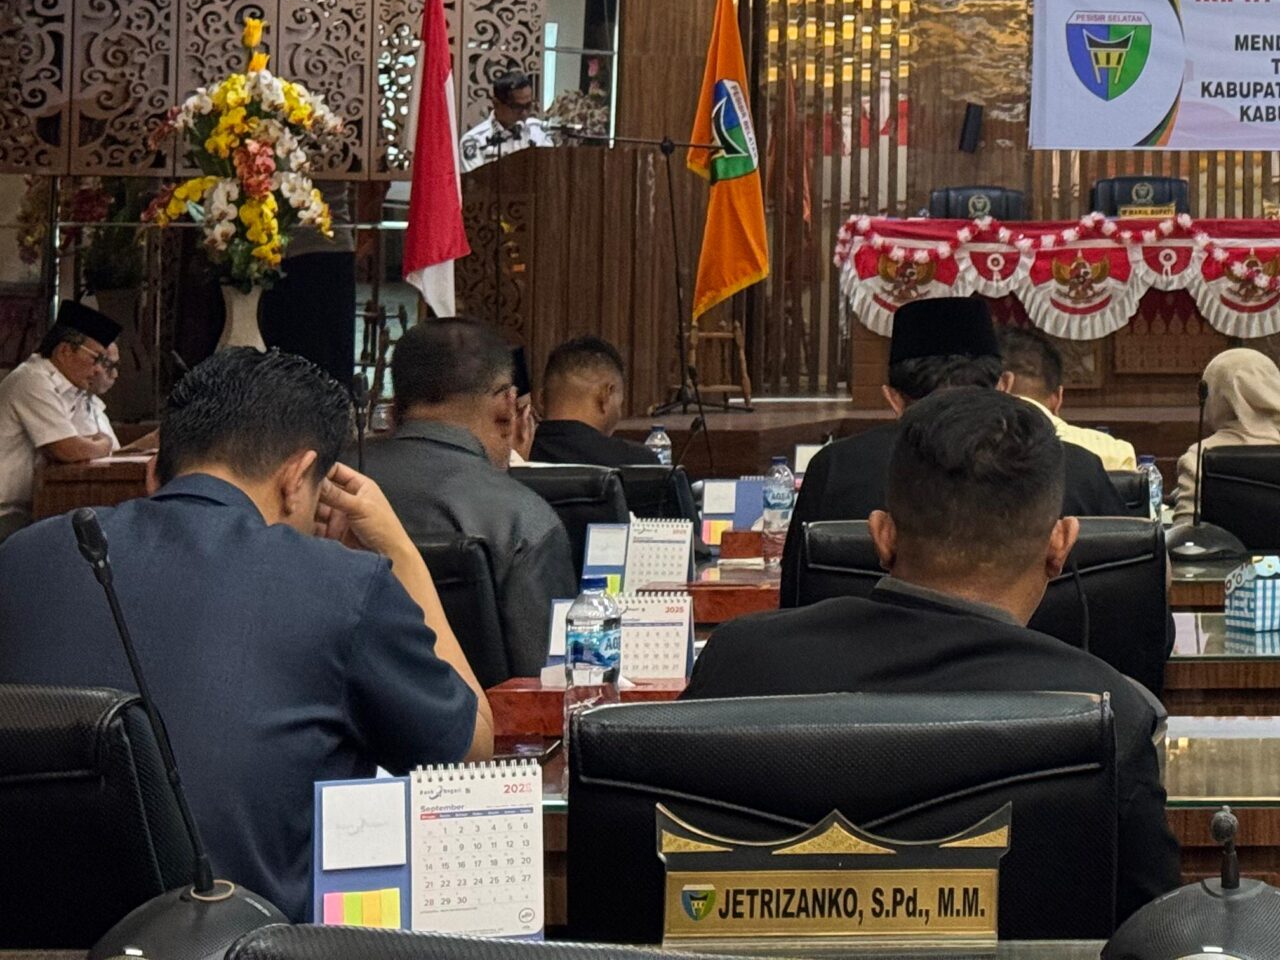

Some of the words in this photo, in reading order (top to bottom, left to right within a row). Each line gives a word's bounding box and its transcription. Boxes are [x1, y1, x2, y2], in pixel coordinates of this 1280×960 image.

[420, 804, 465, 812] September
[718, 887, 864, 925] JETRIZANKO,
[871, 887, 930, 923] S.Pd.,
[937, 887, 985, 917] M.M.
